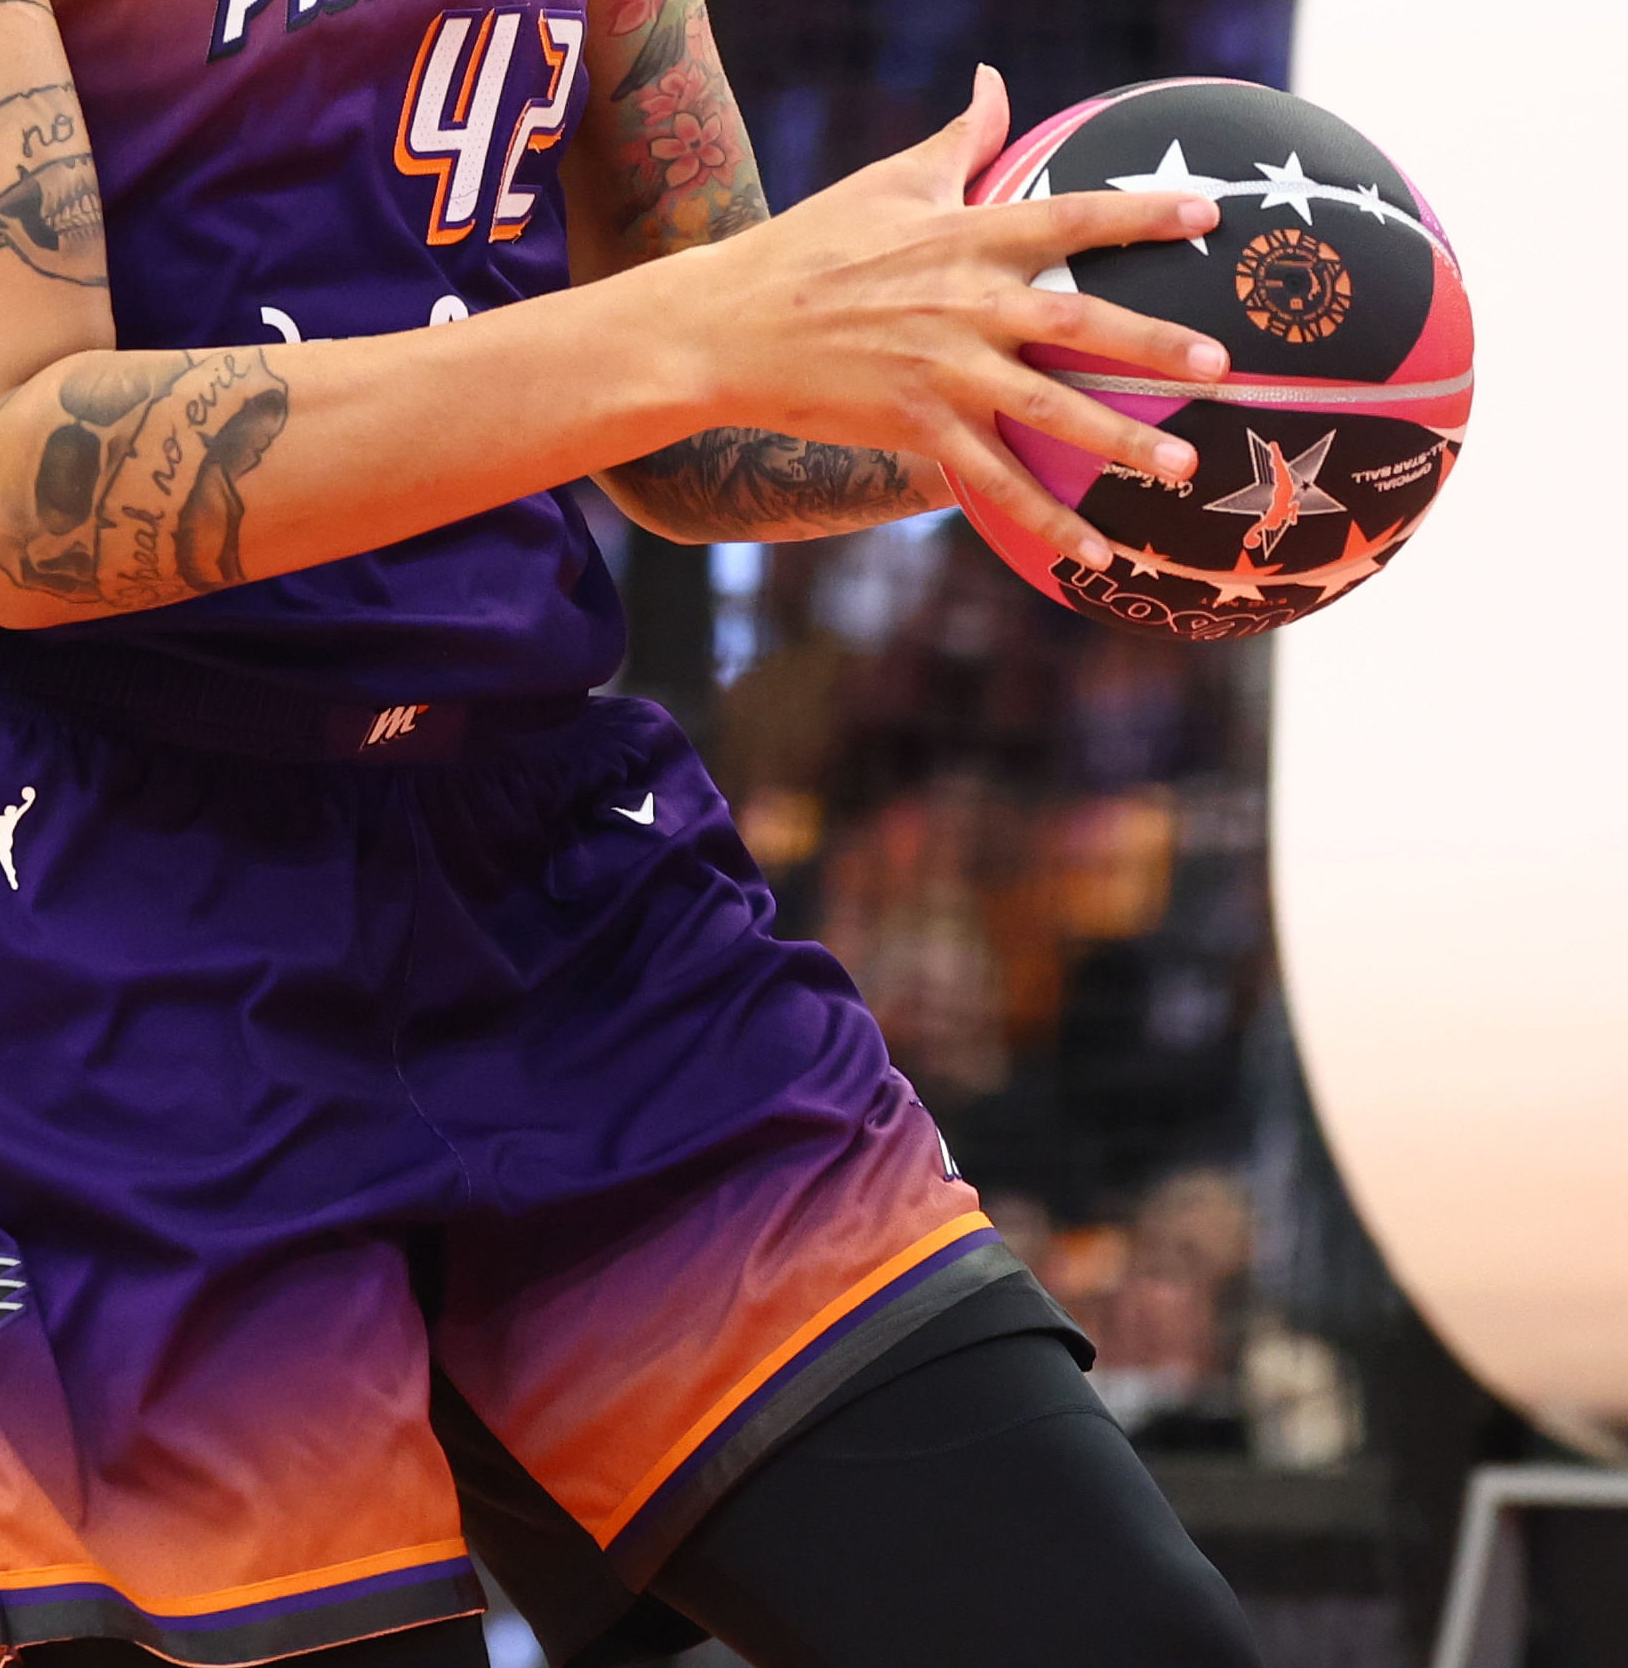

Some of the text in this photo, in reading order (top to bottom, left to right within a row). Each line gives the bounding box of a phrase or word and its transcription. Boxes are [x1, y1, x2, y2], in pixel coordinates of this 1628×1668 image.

[21, 112, 75, 158] no
[394, 2, 587, 245] 42
[152, 430, 183, 497] no
[186, 353, 251, 427] evil
[1351, 465, 1393, 484] BALL
